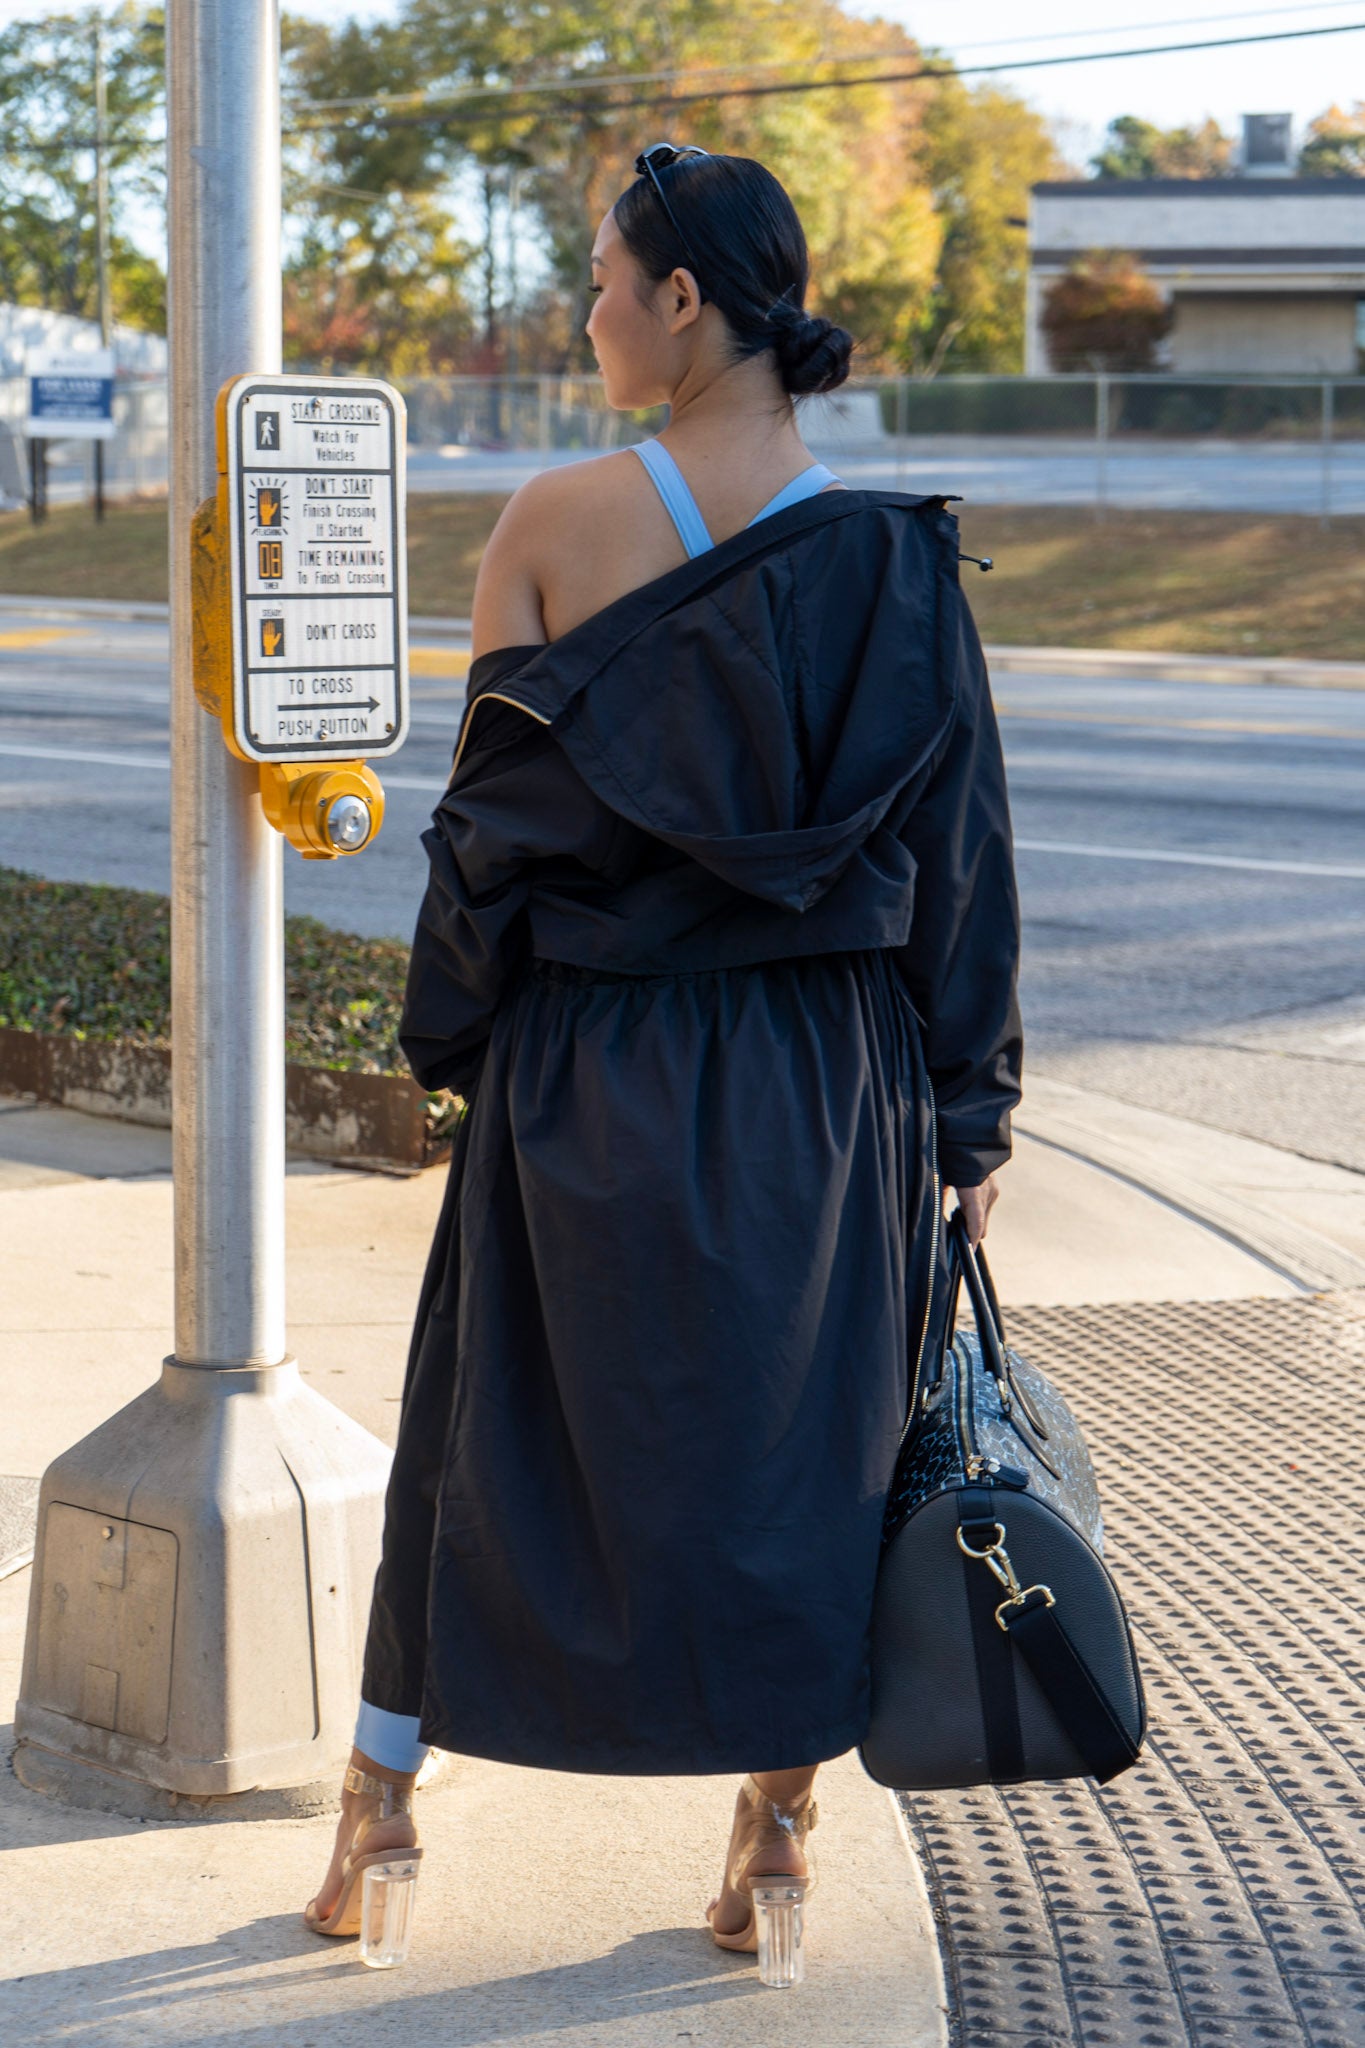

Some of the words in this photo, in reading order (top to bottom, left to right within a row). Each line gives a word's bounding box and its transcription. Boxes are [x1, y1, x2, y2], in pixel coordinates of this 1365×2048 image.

[291, 402, 322, 420] START
[328, 404, 380, 421] CROSSING
[313, 429, 340, 443] Watch
[345, 430, 359, 444] For
[315, 449, 356, 462] Vehicles
[305, 478, 336, 494] DON'T
[342, 479, 373, 495] START
[303, 504, 332, 518] Finish
[336, 505, 376, 522] Crossing
[328, 524, 363, 538] Started
[298, 550, 321, 566] TIME
[326, 551, 384, 567] REMAINING
[297, 571, 308, 584] To
[315, 571, 340, 585] Finish
[347, 571, 386, 588] Crossing
[306, 625, 337, 641] DON'T
[342, 624, 376, 639] CROSS
[289, 679, 305, 695] TO
[312, 678, 354, 694] CROSS
[278, 721, 313, 737] PUSH
[319, 718, 368, 735] BUTTON
